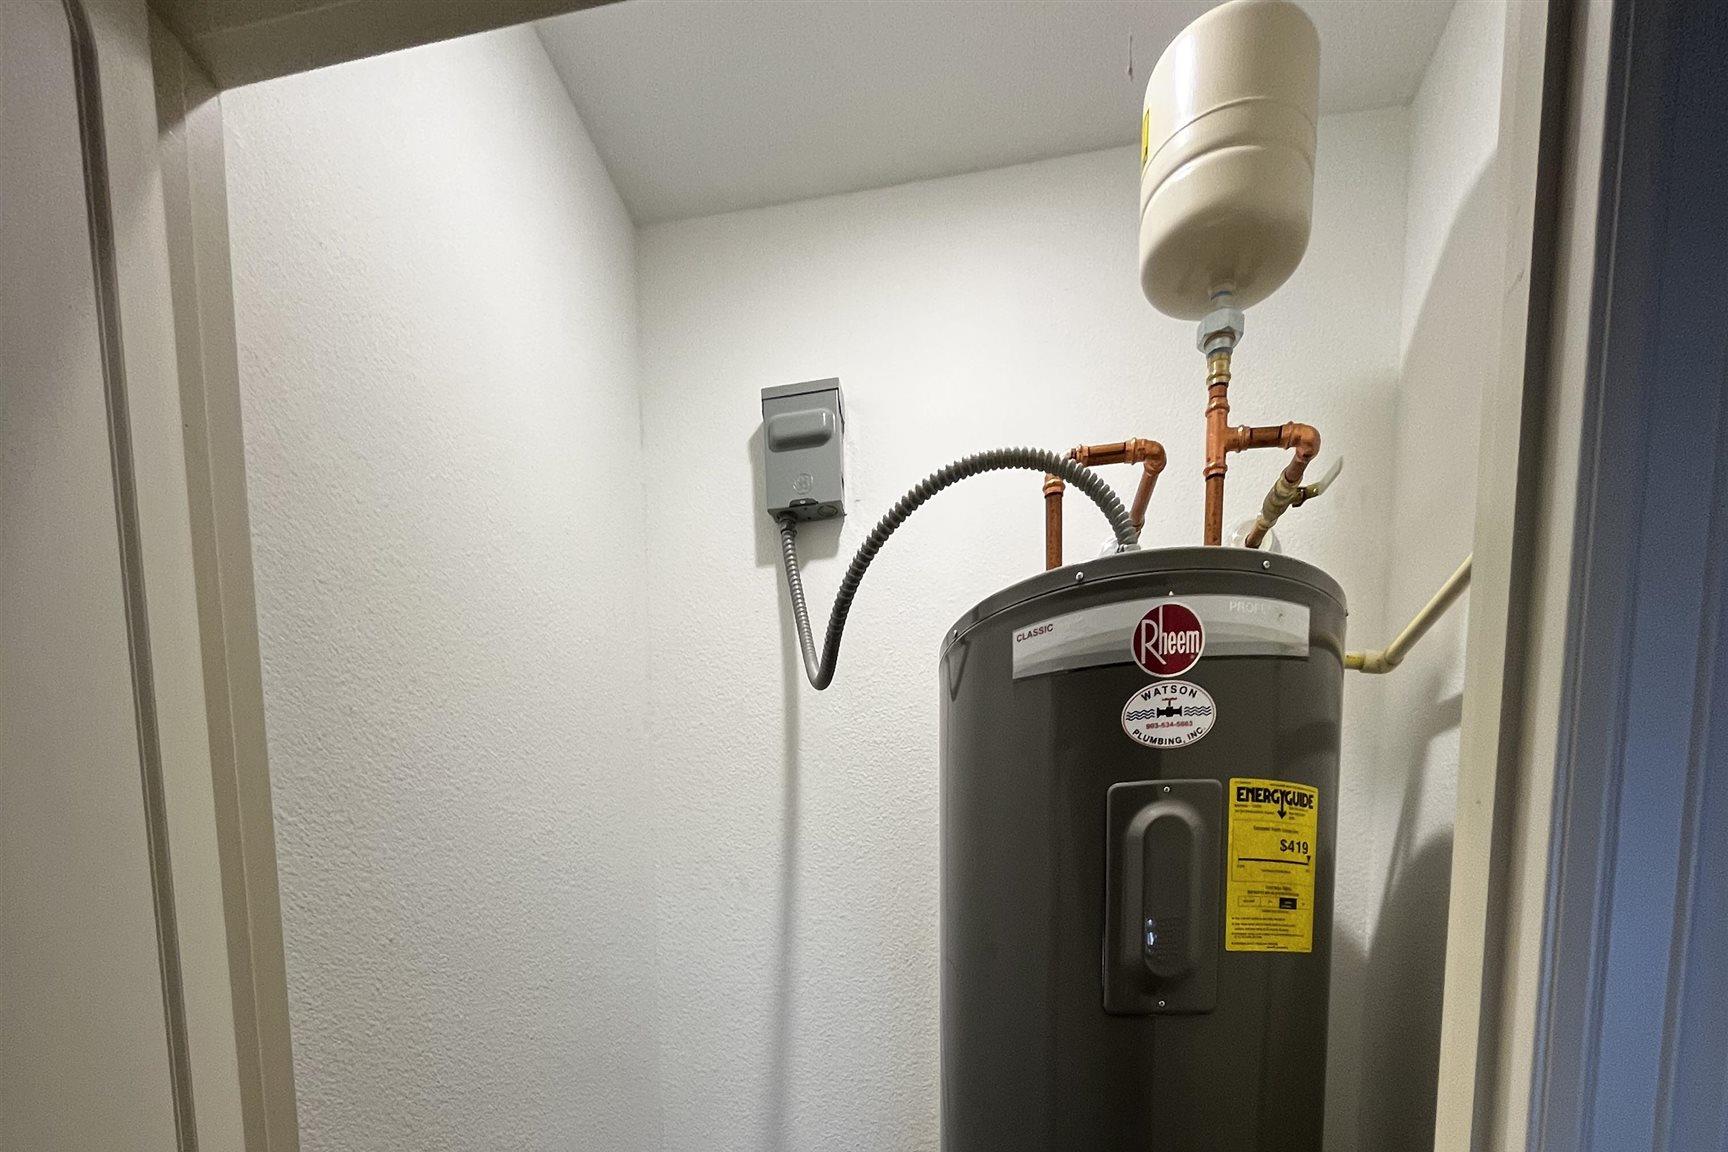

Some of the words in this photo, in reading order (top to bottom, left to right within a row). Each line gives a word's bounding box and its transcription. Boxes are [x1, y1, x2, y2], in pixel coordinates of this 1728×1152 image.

[1016, 623, 1054, 643] CLASSIC
[1141, 605, 1200, 665] Rheem
[1141, 685, 1197, 701] WATSON
[1132, 728, 1186, 746] PLUMBING,
[1187, 726, 1206, 741] INC.
[1280, 839, 1309, 855] $419
